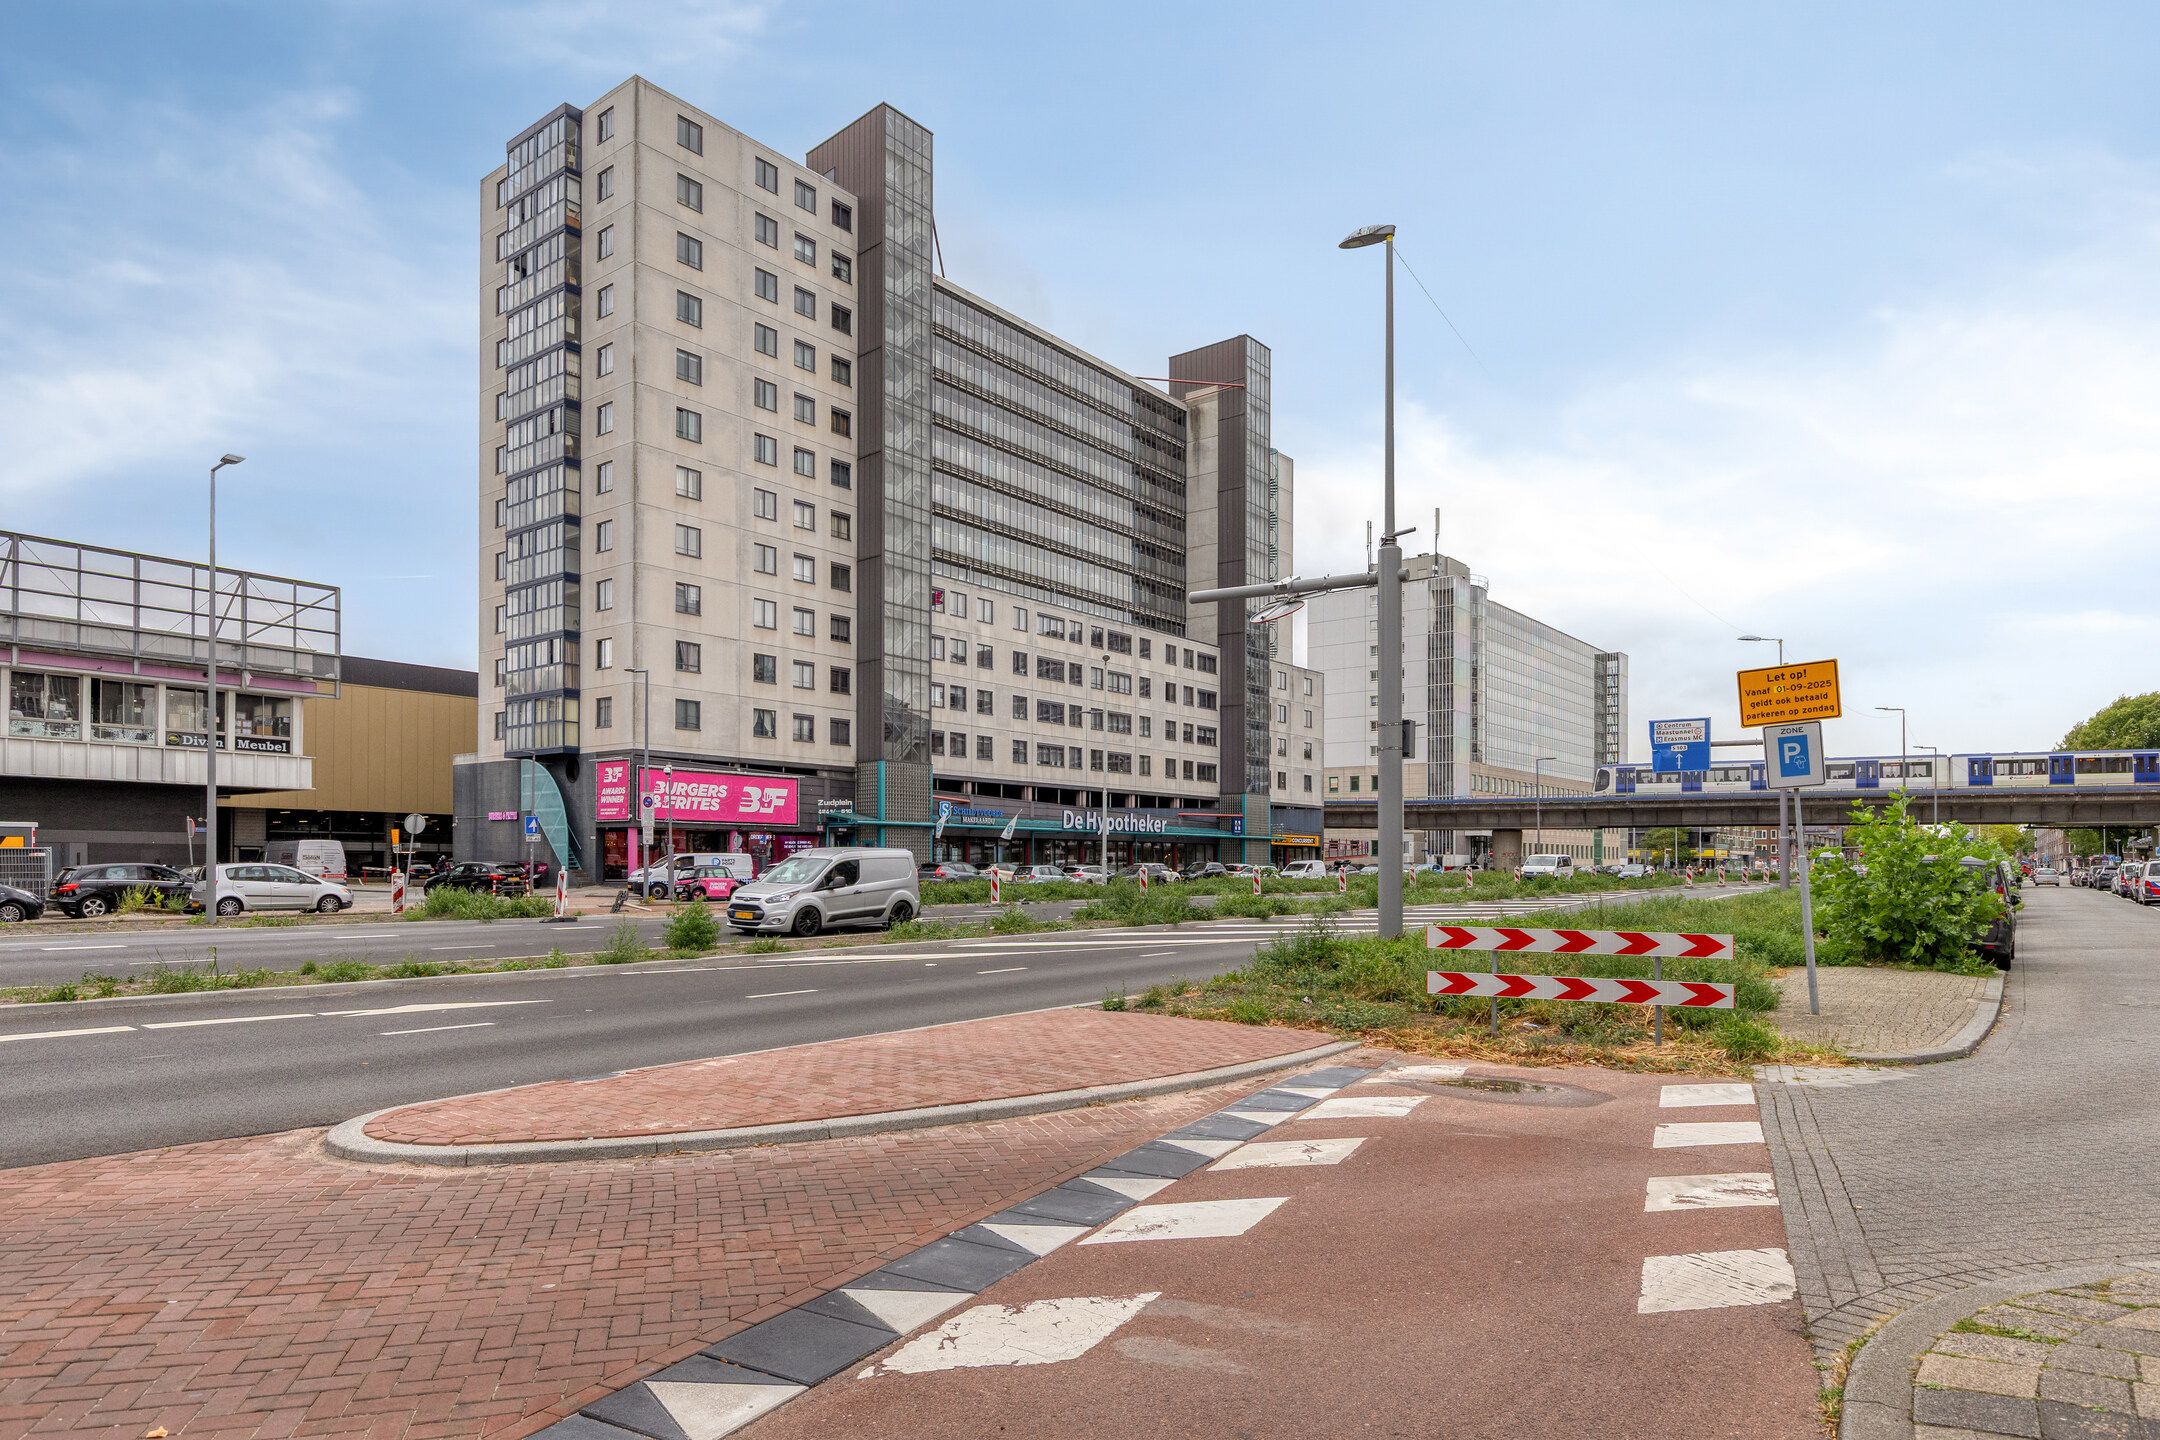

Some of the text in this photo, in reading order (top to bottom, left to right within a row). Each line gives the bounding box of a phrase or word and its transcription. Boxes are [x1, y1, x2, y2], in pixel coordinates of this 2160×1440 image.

[1767, 669, 1807, 682] Let op!
[1745, 680, 1832, 697] Vanaf 01-09-2025
[1750, 692, 1828, 709] geldt ook betaald
[1746, 704, 1835, 721] parkeren op zondag
[182, 735, 287, 752] Divn Meubel
[1784, 743, 1801, 763] P
[602, 787, 626, 795] AWARDS
[654, 781, 728, 798] BURGERS
[600, 796, 624, 804] WINNER
[818, 799, 853, 807] Zuidplein
[1063, 810, 1167, 835] De Hypotheker
